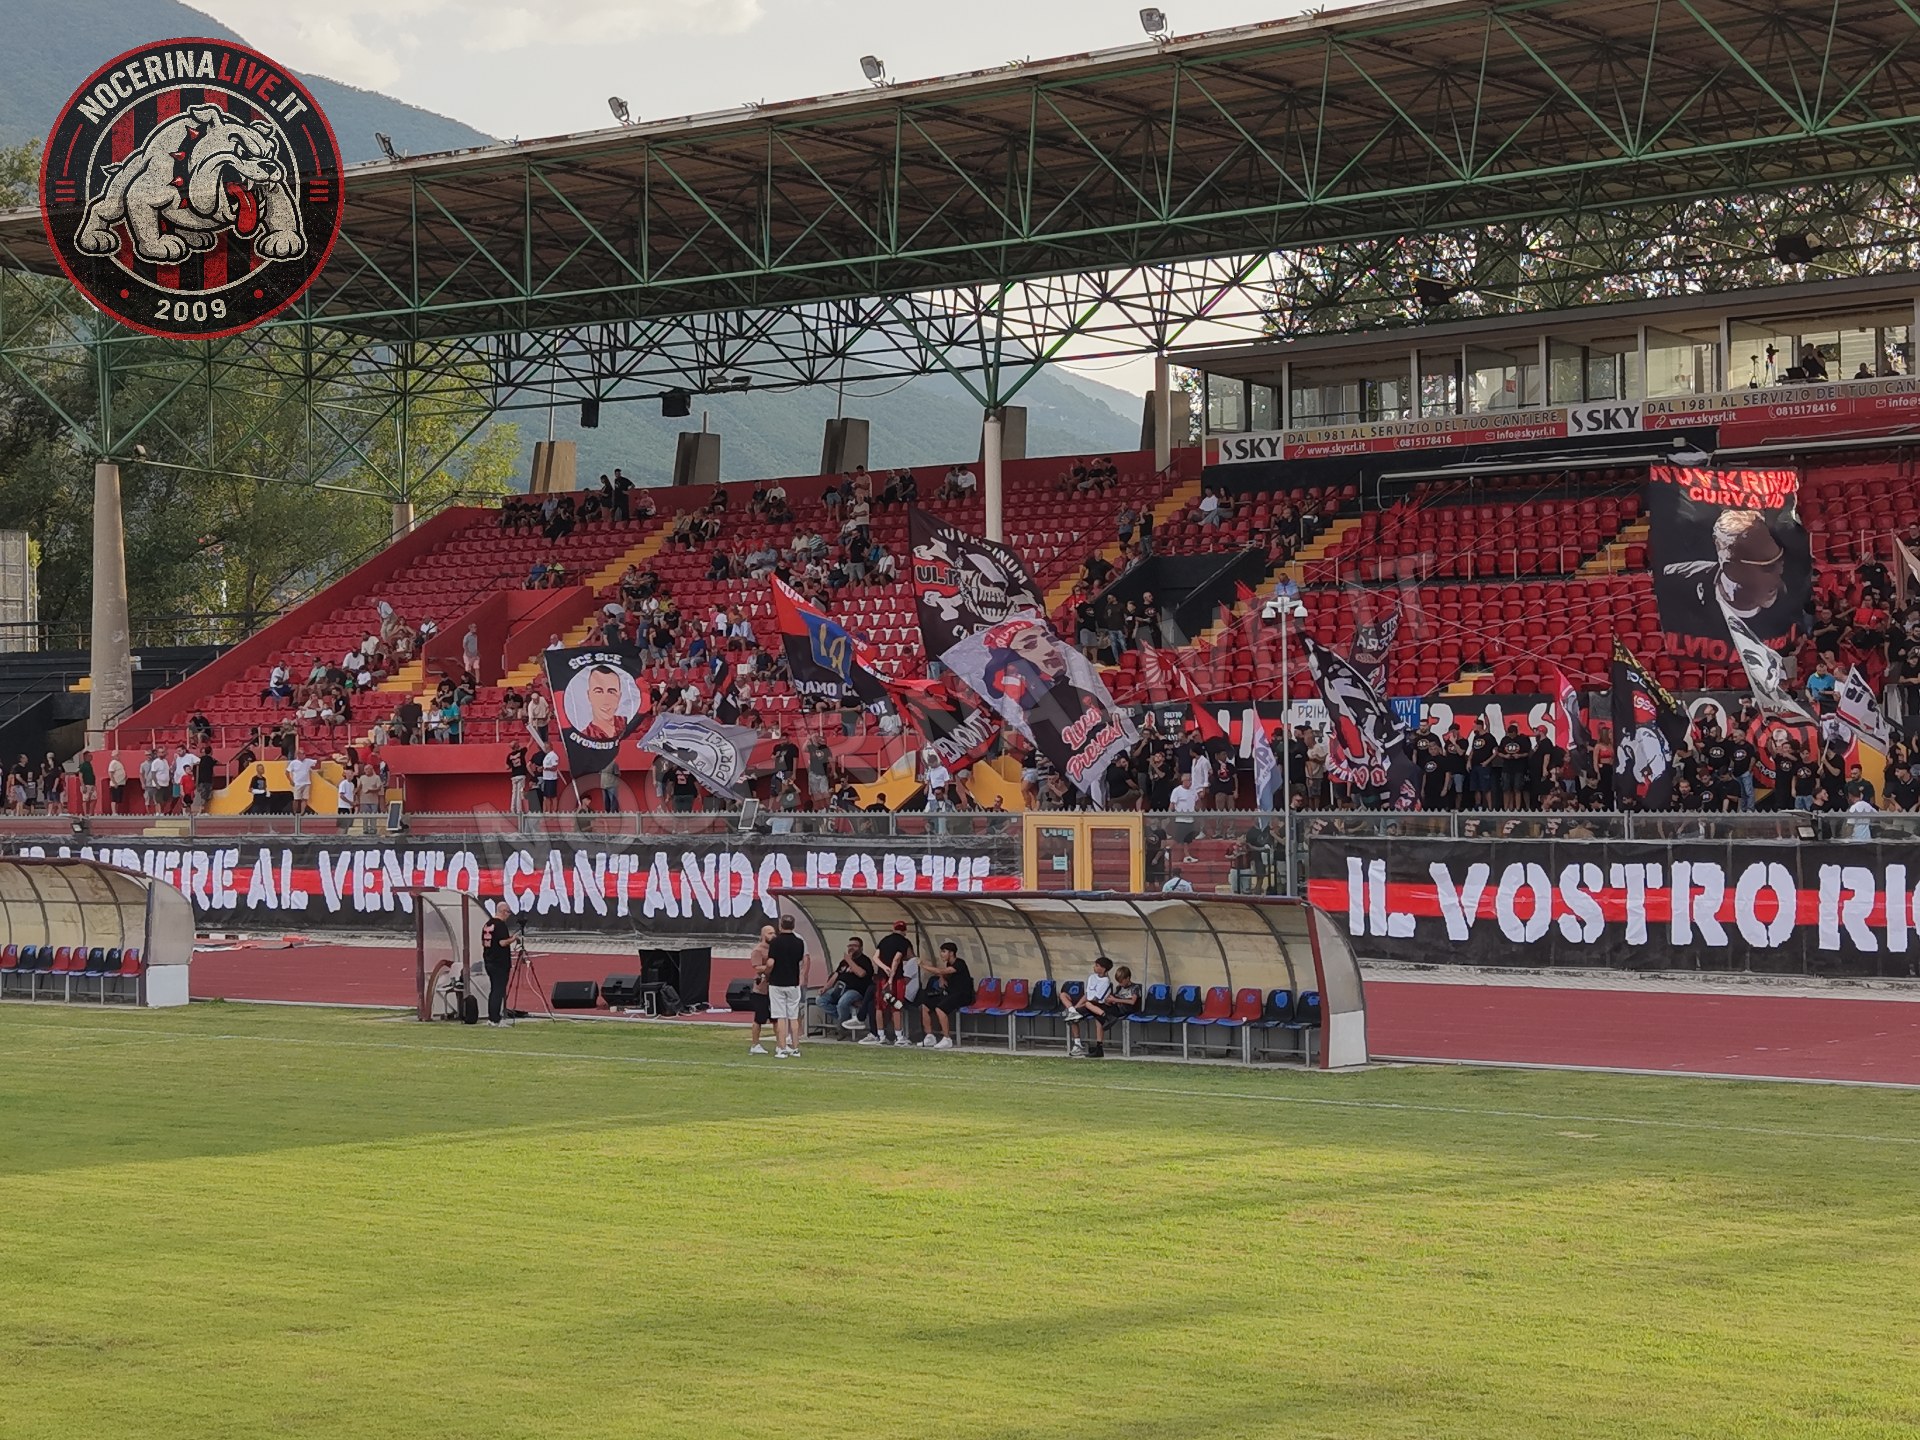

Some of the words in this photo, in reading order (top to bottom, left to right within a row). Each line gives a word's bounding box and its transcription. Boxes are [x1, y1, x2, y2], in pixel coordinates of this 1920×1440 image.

[1647, 402, 1675, 414] DAL
[1681, 399, 1713, 411] 1981
[1720, 396, 1738, 407] AL
[1743, 389, 1810, 406] SERVIZIO
[1816, 386, 1845, 399] DEL
[1849, 383, 1878, 396] TUO
[1885, 380, 1920, 394] CAN
[1669, 411, 1737, 427] www.skysrl.it
[1775, 402, 1837, 416] 0815178416
[1288, 433, 1315, 445] DAL
[1317, 430, 1346, 442] 1981
[1351, 428, 1366, 439] AL
[1371, 422, 1430, 438] SERVIZIO
[1435, 420, 1459, 433] DEL
[1462, 418, 1489, 430] TUO
[1307, 441, 1366, 456] www.skysrl.it
[1400, 435, 1452, 449] 0815178416
[1496, 425, 1556, 441] info@skysrl.it
[1689, 487, 1762, 510] CURVA
[1395, 698, 1417, 714] VIVI
[247, 848, 309, 911] AL
[1346, 856, 1417, 938] IL
[1427, 861, 1798, 949] VOSTRO
